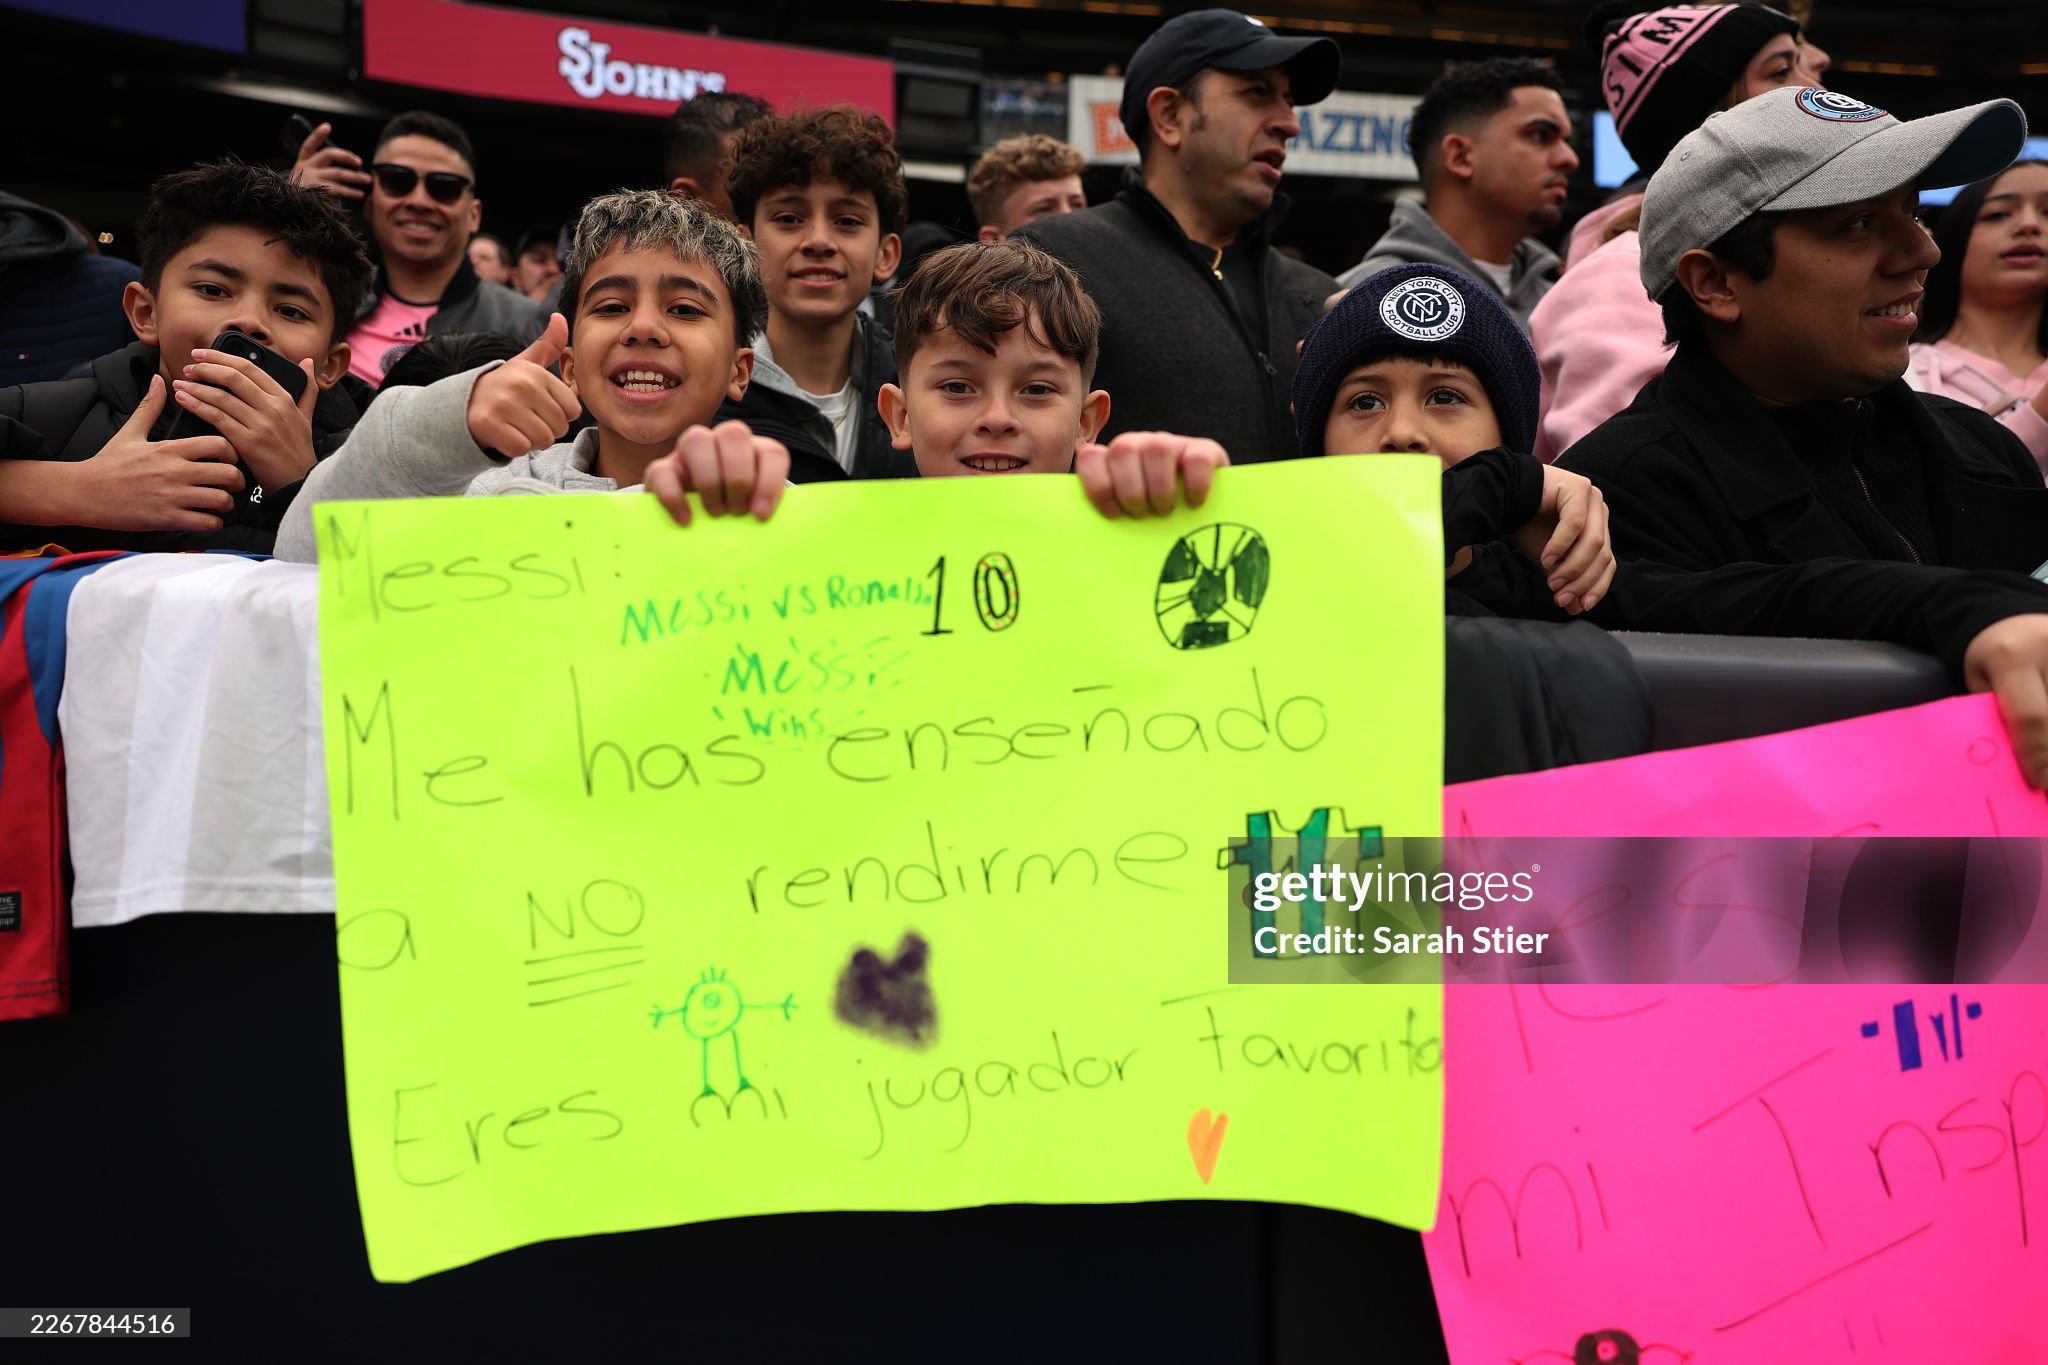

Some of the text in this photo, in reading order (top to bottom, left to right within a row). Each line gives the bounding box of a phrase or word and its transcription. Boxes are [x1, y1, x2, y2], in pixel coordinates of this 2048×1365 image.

[1386, 309, 1459, 337] FOOTBALL CLUB
[1387, 280, 1461, 307] NEW YORK CITY
[342, 681, 504, 821] Me
[570, 666, 766, 796] has
[336, 909, 417, 971] a
[526, 879, 645, 948] NO
[746, 820, 1190, 914] rendirme
[393, 1081, 624, 1187] Eres
[690, 1063, 788, 1128] mi
[857, 1029, 1141, 1161] jugador
[1448, 1125, 1610, 1279] mi
[1692, 1047, 2048, 1333] Insp
